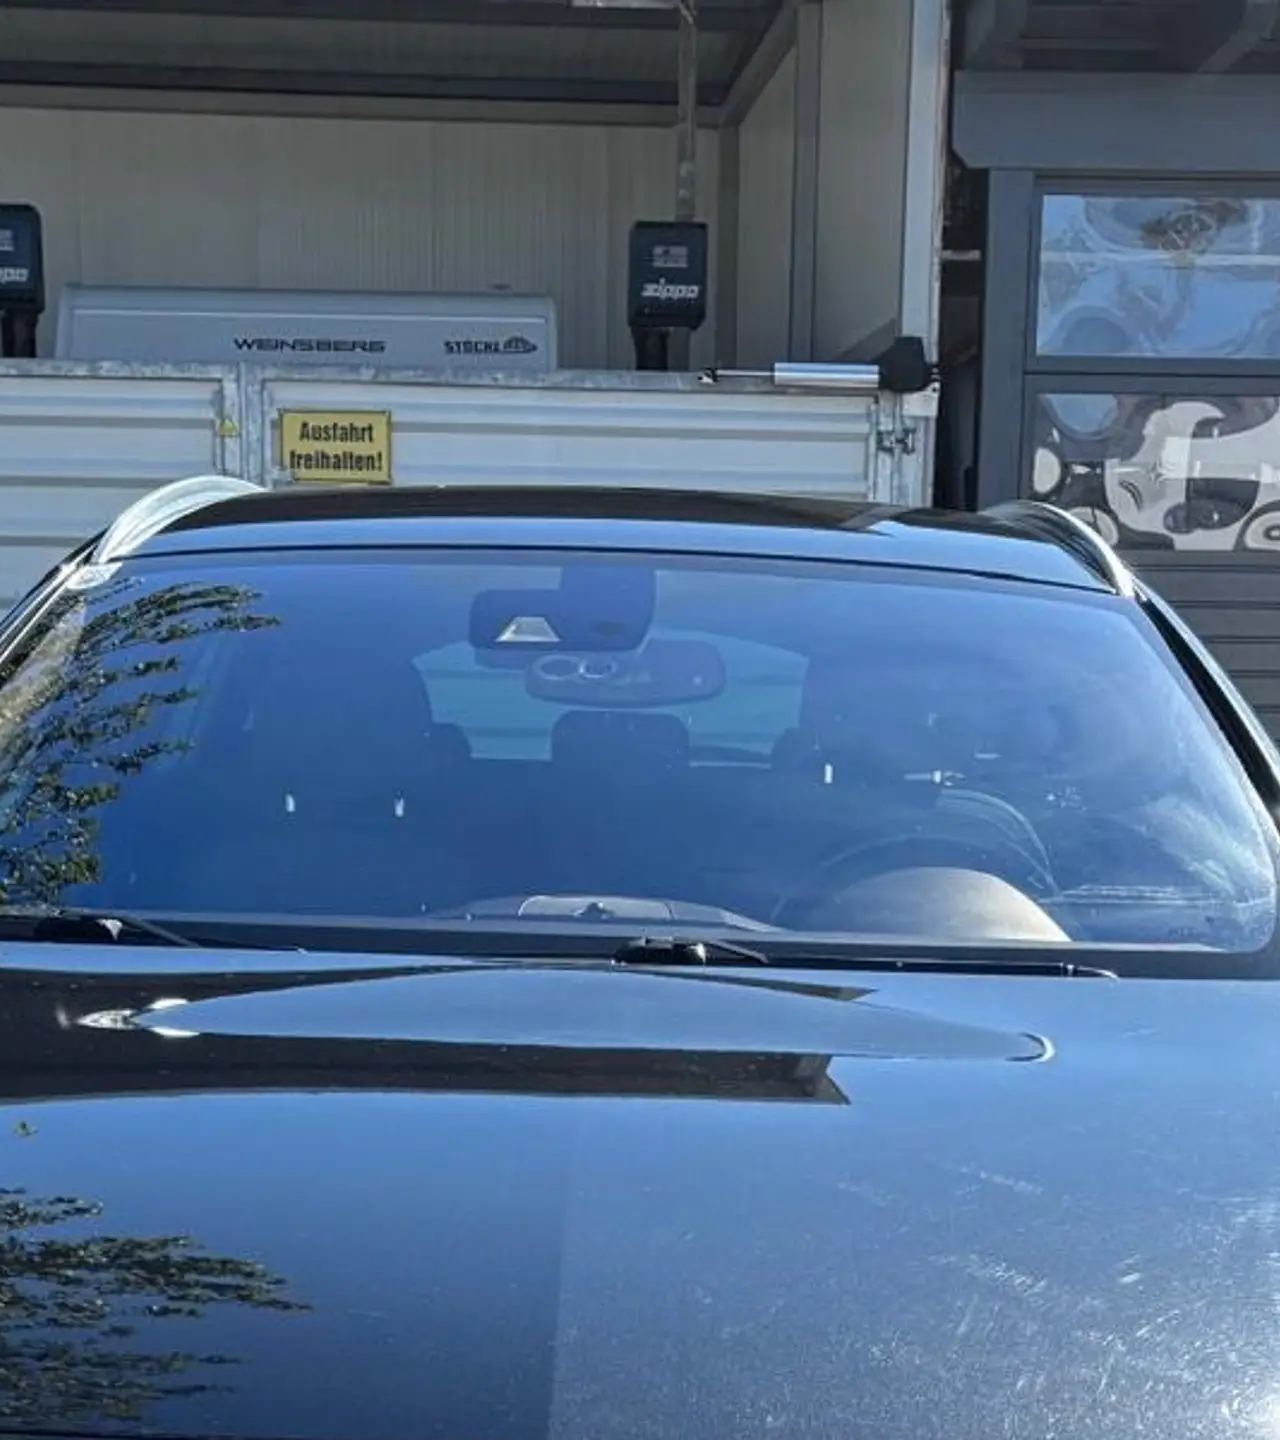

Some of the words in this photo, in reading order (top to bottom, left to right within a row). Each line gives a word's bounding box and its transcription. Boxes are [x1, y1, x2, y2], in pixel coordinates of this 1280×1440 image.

[233, 337, 387, 353] WEINSBERG
[299, 421, 373, 442] Ausfahrt
[289, 450, 382, 471] freihalten!
